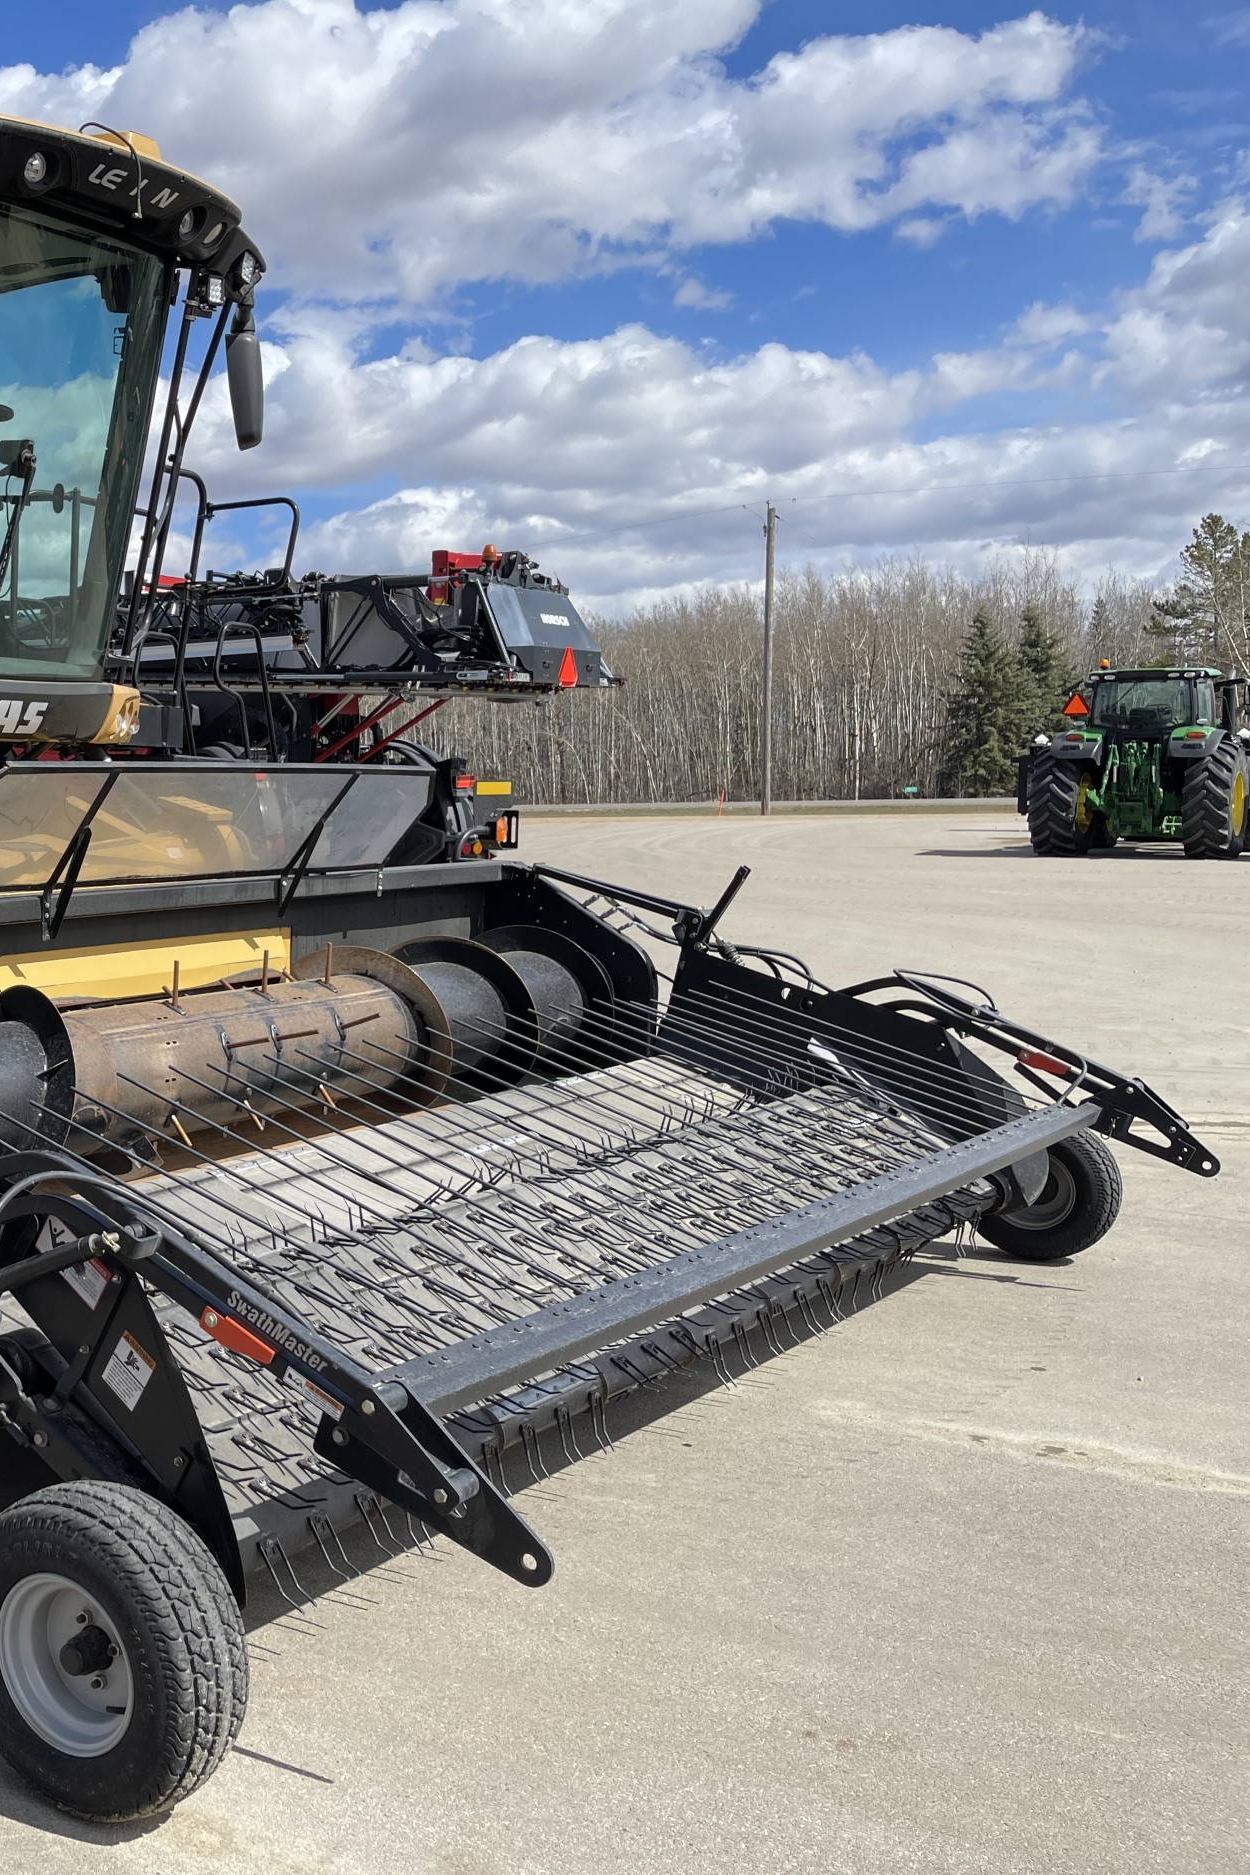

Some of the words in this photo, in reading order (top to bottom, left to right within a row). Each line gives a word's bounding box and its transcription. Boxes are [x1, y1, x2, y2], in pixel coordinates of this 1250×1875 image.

[88, 163, 180, 209] LEIN
[539, 613, 570, 627] HORSCH
[227, 1290, 328, 1372] SwathMaster
